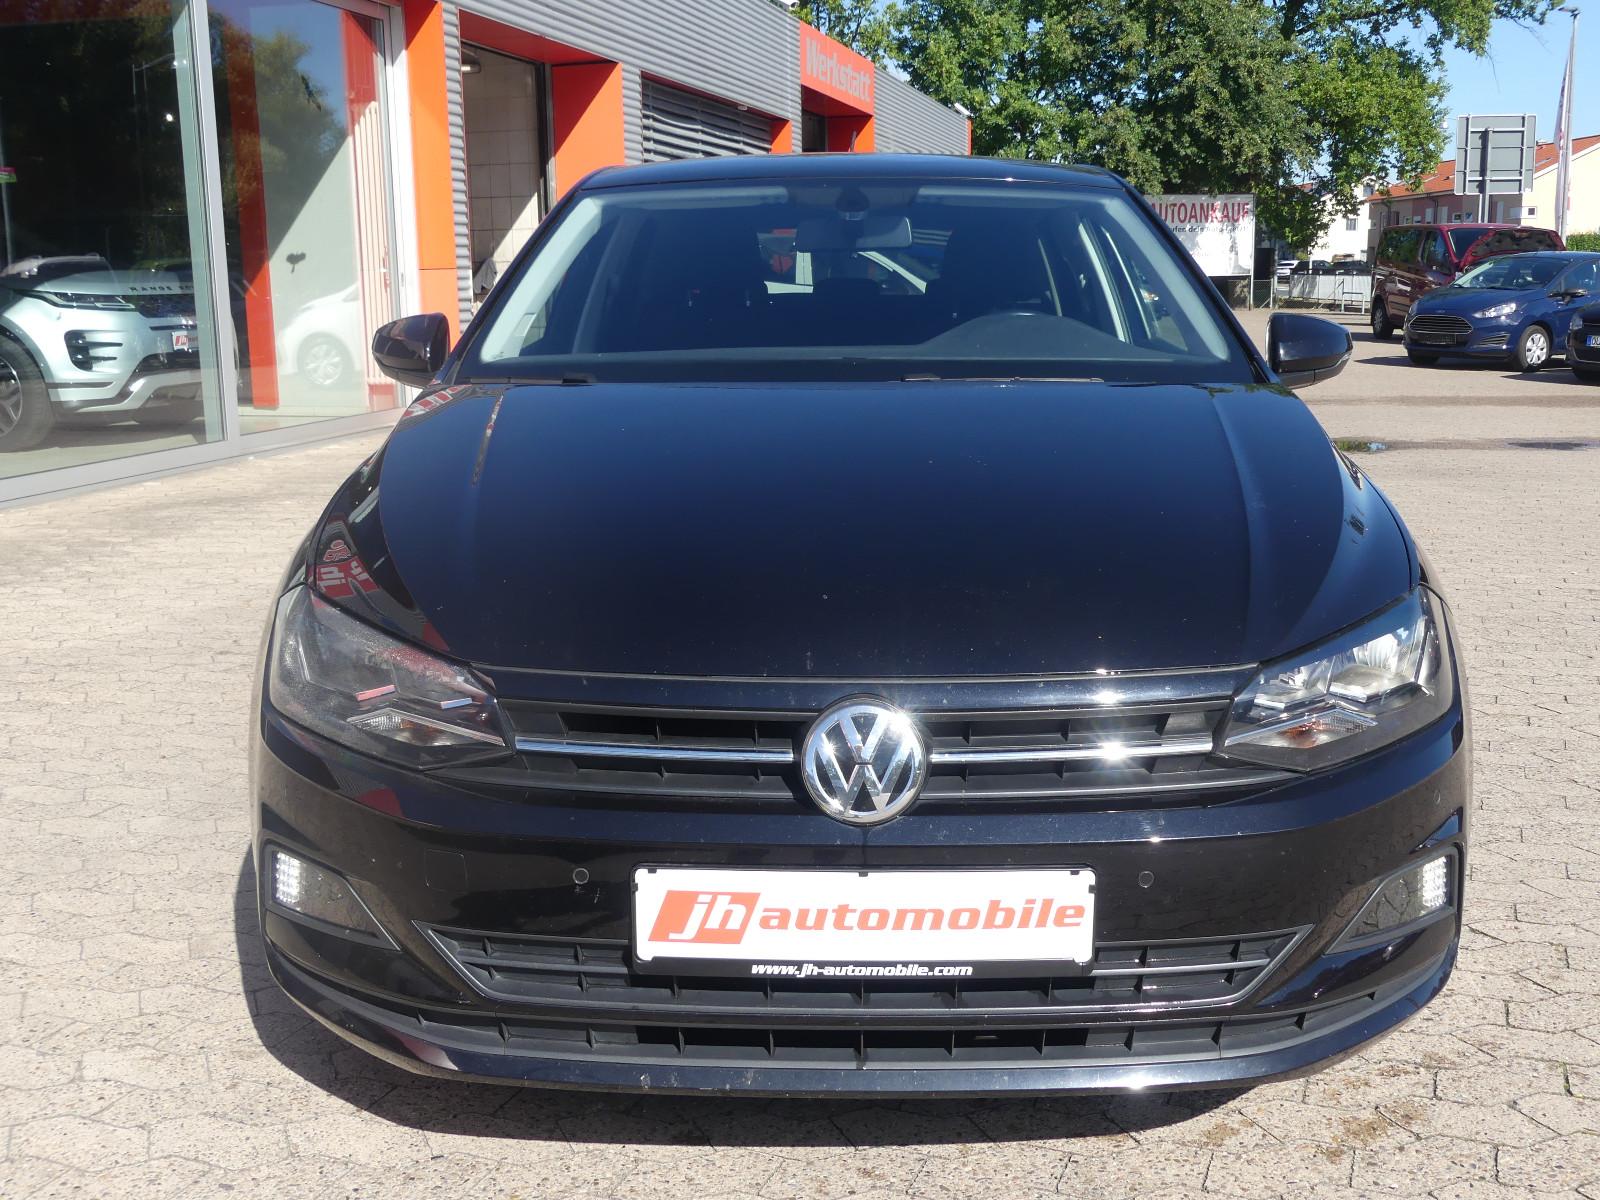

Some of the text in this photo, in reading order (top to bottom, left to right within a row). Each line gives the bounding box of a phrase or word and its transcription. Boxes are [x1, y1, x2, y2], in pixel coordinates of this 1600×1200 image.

[805, 37, 871, 102] Werkstatt
[667, 893, 1086, 941] jh automobile
[751, 963, 973, 978] www.jh-automobile.com
